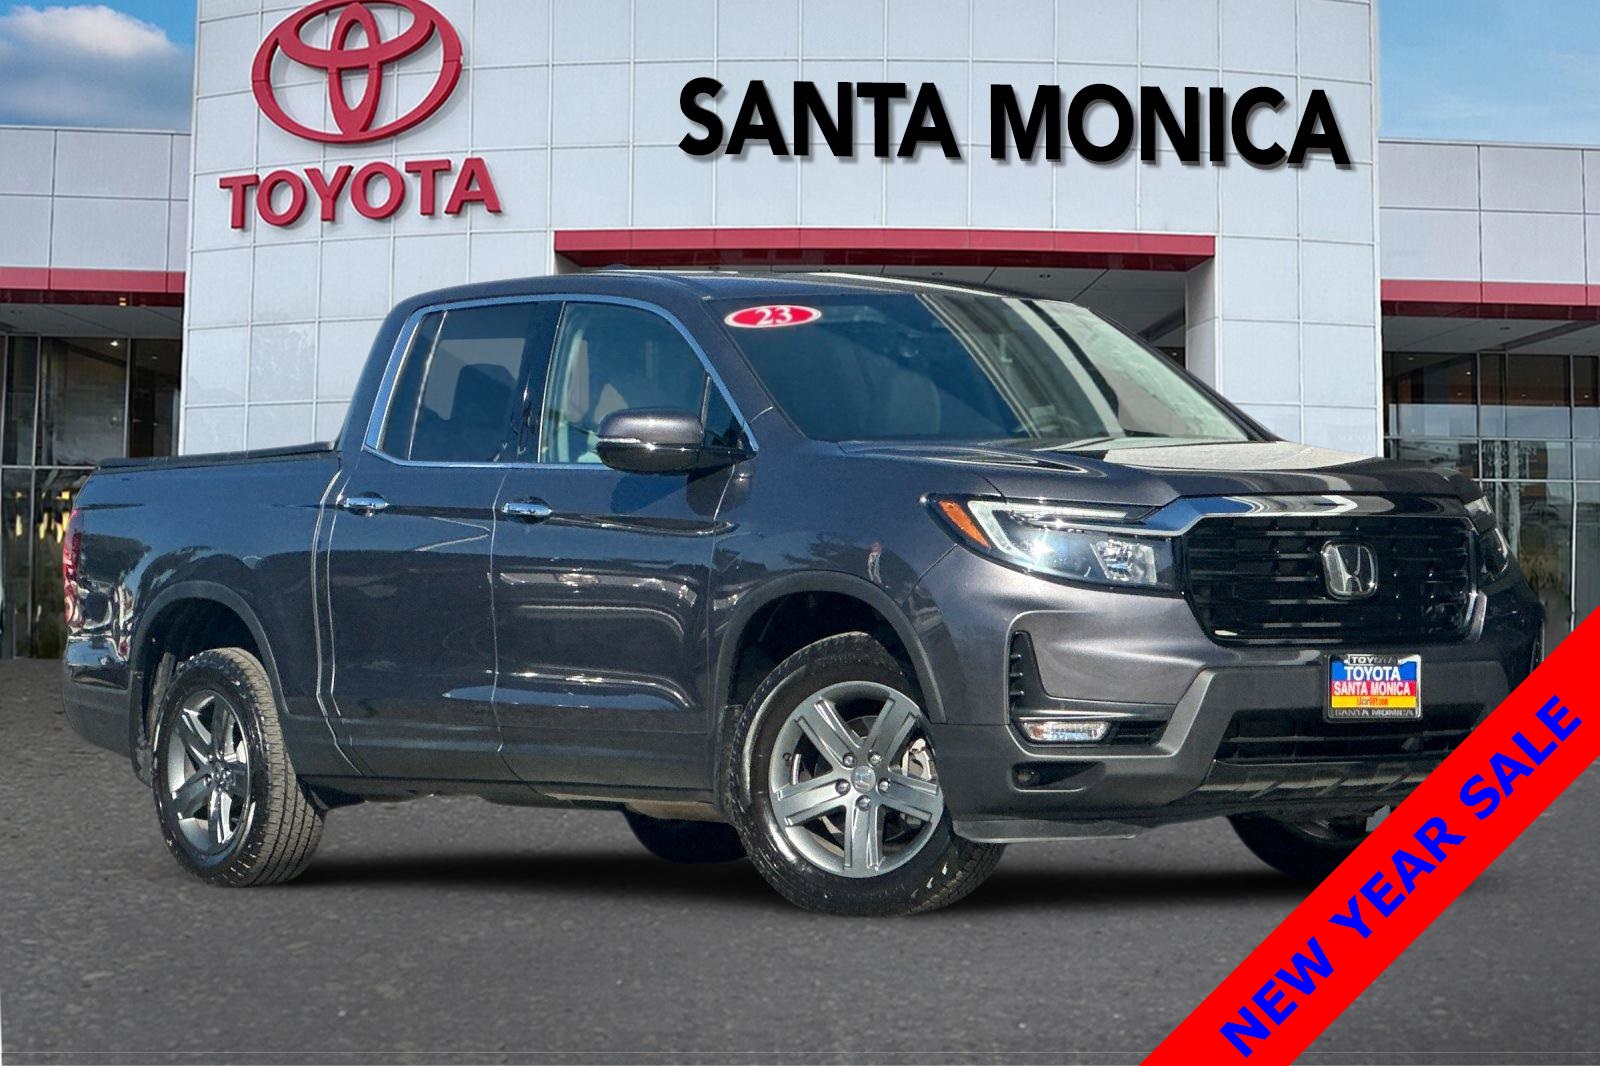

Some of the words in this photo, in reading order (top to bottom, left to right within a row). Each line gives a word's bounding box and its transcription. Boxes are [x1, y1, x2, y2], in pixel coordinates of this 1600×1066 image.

[678, 76, 963, 159] SANTA
[989, 82, 1352, 168] MONICA
[220, 157, 502, 229] TOYOTA
[755, 306, 793, 326] 23
[1344, 666, 1401, 681] TOYOTA
[1333, 682, 1368, 696] SANTA
[1371, 682, 1411, 696] MONICA
